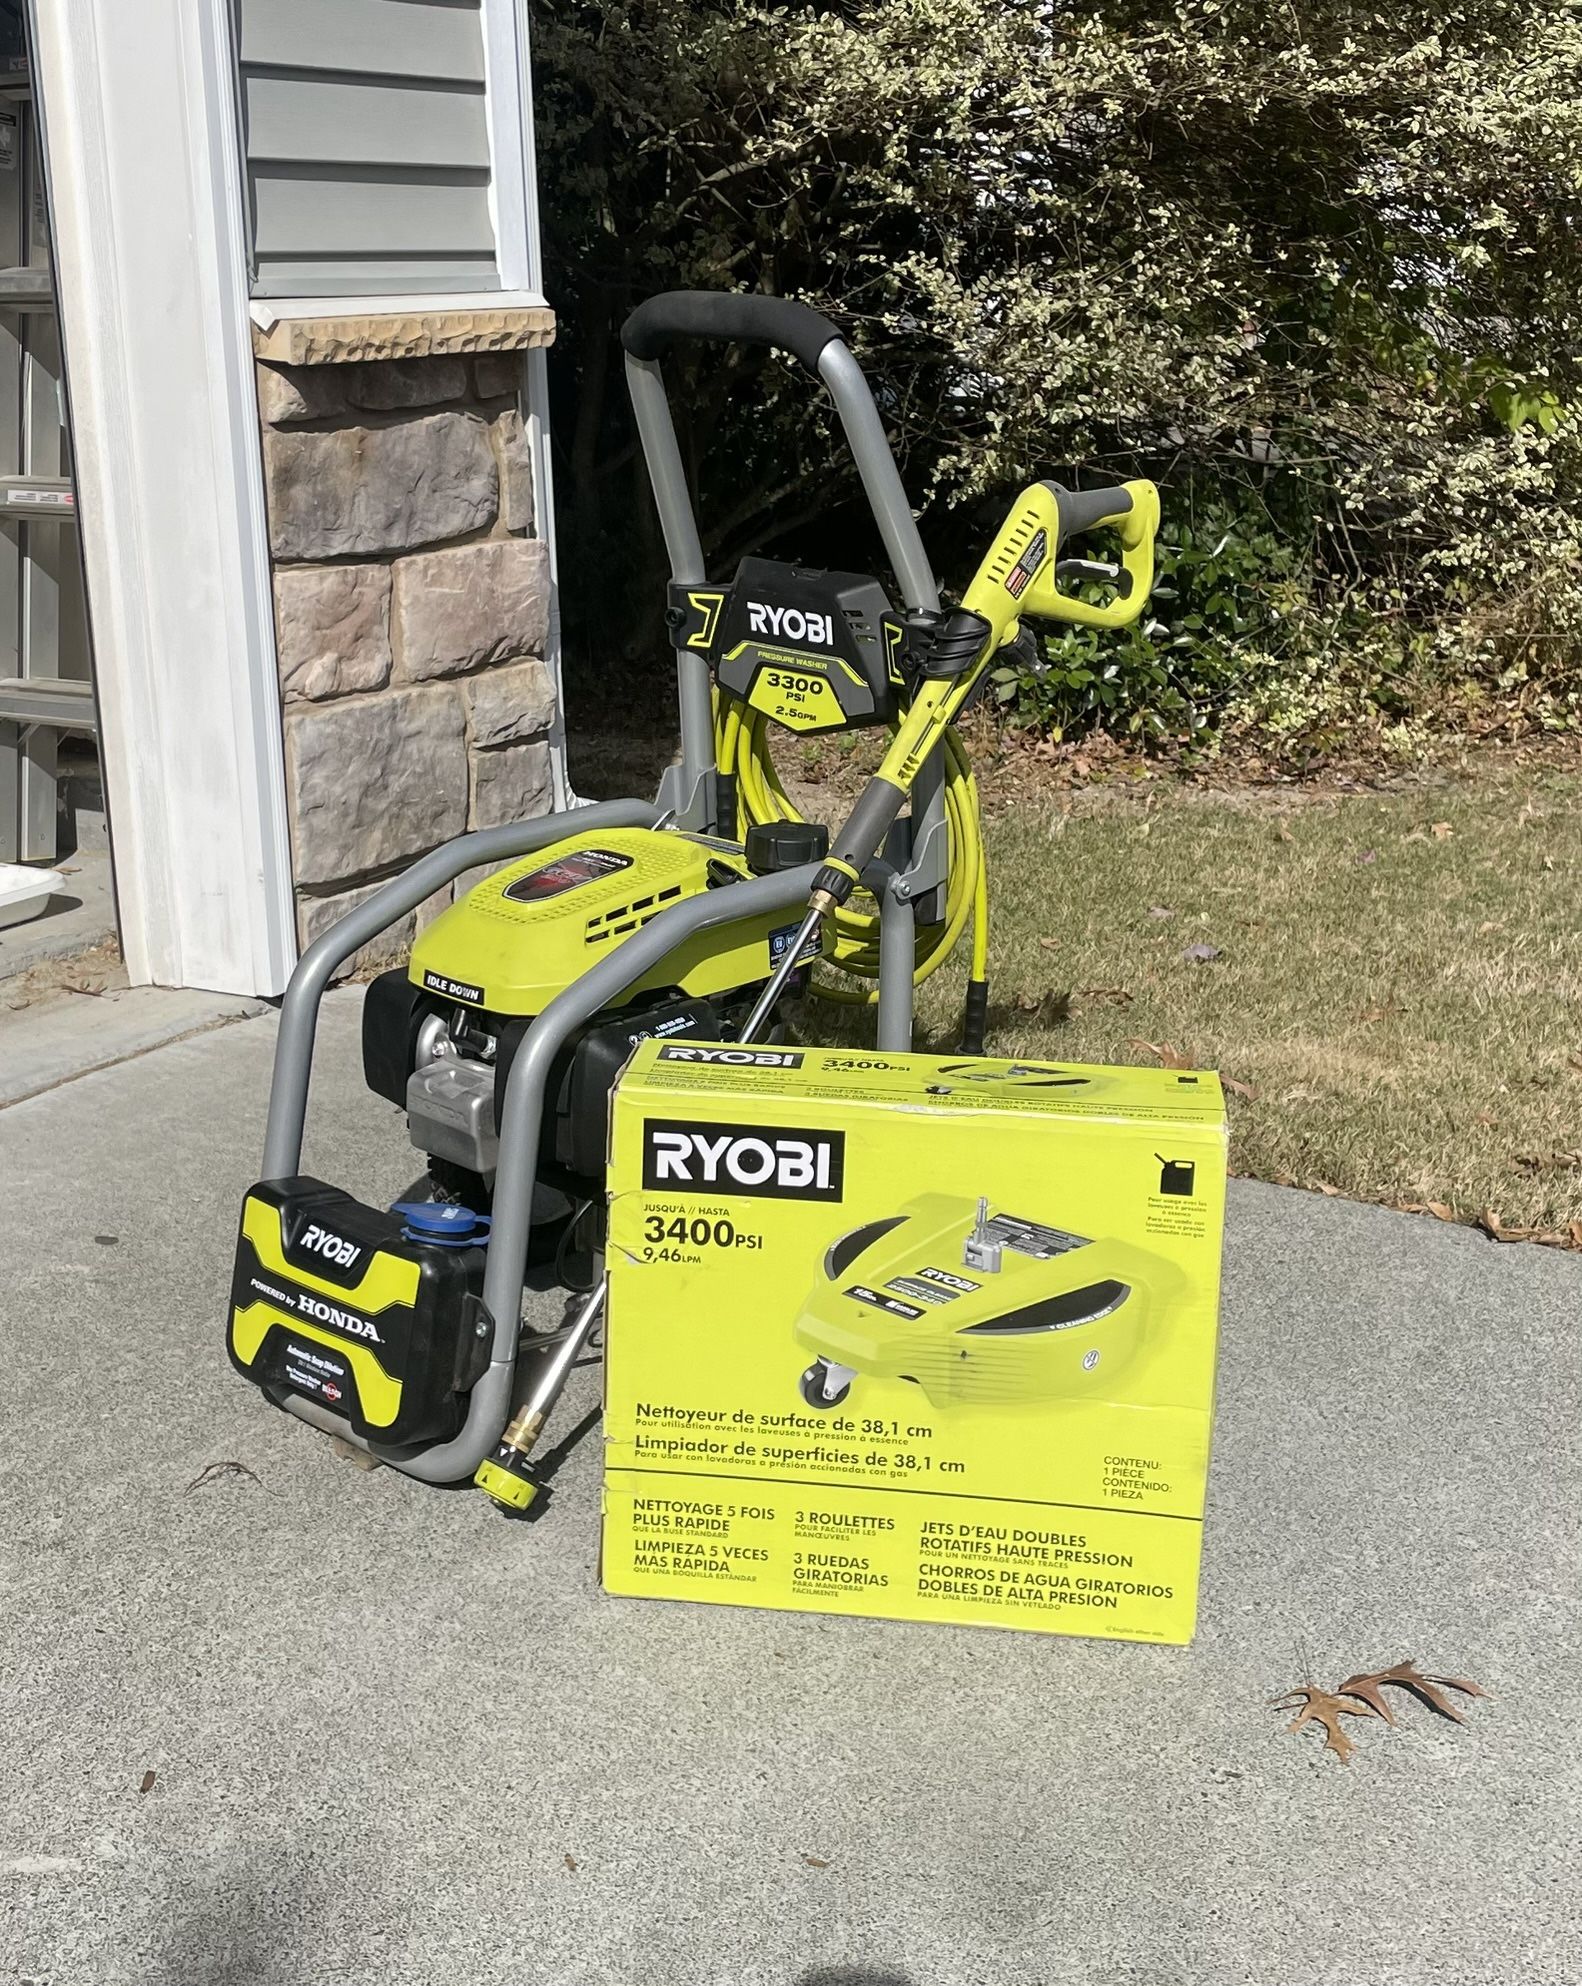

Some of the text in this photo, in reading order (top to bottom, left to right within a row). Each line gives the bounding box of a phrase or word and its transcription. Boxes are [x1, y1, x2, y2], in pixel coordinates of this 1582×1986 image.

[747, 601, 834, 645] RYOBI
[757, 651, 828, 670] PRESSURE WASHER
[767, 672, 824, 695] 3300
[786, 691, 805, 702] PSI
[775, 705, 817, 721] 2.5GPM
[582, 850, 628, 866] HONDA
[427, 975, 479, 1000] IDLE DOWN
[667, 1047, 795, 1067] RYOBI
[823, 1059, 911, 1072] 3400PSI
[653, 1131, 831, 1189] RYOBI
[643, 1203, 686, 1214] JUSQU'À
[698, 1207, 730, 1216] HASTA
[644, 1215, 763, 1249] 3400PSI
[300, 1224, 361, 1268] RYOBI
[643, 1247, 702, 1264] 9,46LPM
[921, 1268, 979, 1291] RYOBI
[250, 1278, 381, 1342] POWERED by HONDA
[636, 1402, 932, 1438] Nettoyeur de surface de 38,1 cm
[635, 1418, 658, 1427] Pour
[661, 1419, 711, 1431] utilisation
[714, 1424, 737, 1432] avec
[740, 1425, 754, 1433] les
[757, 1426, 801, 1437] laveuses
[814, 1431, 856, 1441] pression
[869, 1437, 909, 1446] essence
[634, 1449, 657, 1458] Para
[660, 1452, 683, 1460] usar
[706, 1454, 756, 1466] lavadoras
[810, 1463, 866, 1474] accionadas
[869, 1468, 886, 1476] con
[890, 1470, 908, 1478] gas
[635, 1434, 965, 1473] Limpiador de superficies de 38,1 cm
[1104, 1456, 1162, 1470] CONTENU:
[1104, 1467, 1109, 1475] 1
[1102, 1477, 1172, 1493] CONTENIDO:
[1102, 1488, 1144, 1500] 1 PIEZA
[633, 1499, 775, 1520] NETTOYAGE 5 FOIS
[633, 1513, 730, 1532] PLUS RAPIDE
[795, 1511, 895, 1530] 3 ROULETTES
[820, 1526, 860, 1535] FACILITER
[664, 1527, 683, 1535] BUSE
[685, 1529, 729, 1539] STANDARD
[920, 1521, 1086, 1548] JETS D'EAU DOUBLES
[634, 1539, 769, 1561] LIMPIEZA 5 VECES
[919, 1549, 1069, 1569] POUR UN NETTOYAGE SANS TRACES
[920, 1537, 1133, 1567] ROTATIFS HAUTE PRESSION
[673, 1554, 730, 1573] RÁPIDA
[793, 1552, 870, 1570] 3 RUEDAS
[652, 1567, 671, 1575] UNA
[672, 1569, 713, 1579] BOQUILLA
[793, 1567, 889, 1587] GIRATORIAS
[919, 1563, 1173, 1599] CHORROS DE AGUA GIRATORIOS
[792, 1580, 864, 1592] PARA MANIOBRAR
[918, 1578, 978, 1595] DOBLES
[983, 1585, 1003, 1598] DE
[1007, 1587, 1044, 1601] ALTA
[917, 1591, 939, 1599] PARA
[942, 1593, 961, 1601] UNA
[963, 1595, 1004, 1605] LIMPIEZA
[1004, 1598, 1020, 1606] SIN
